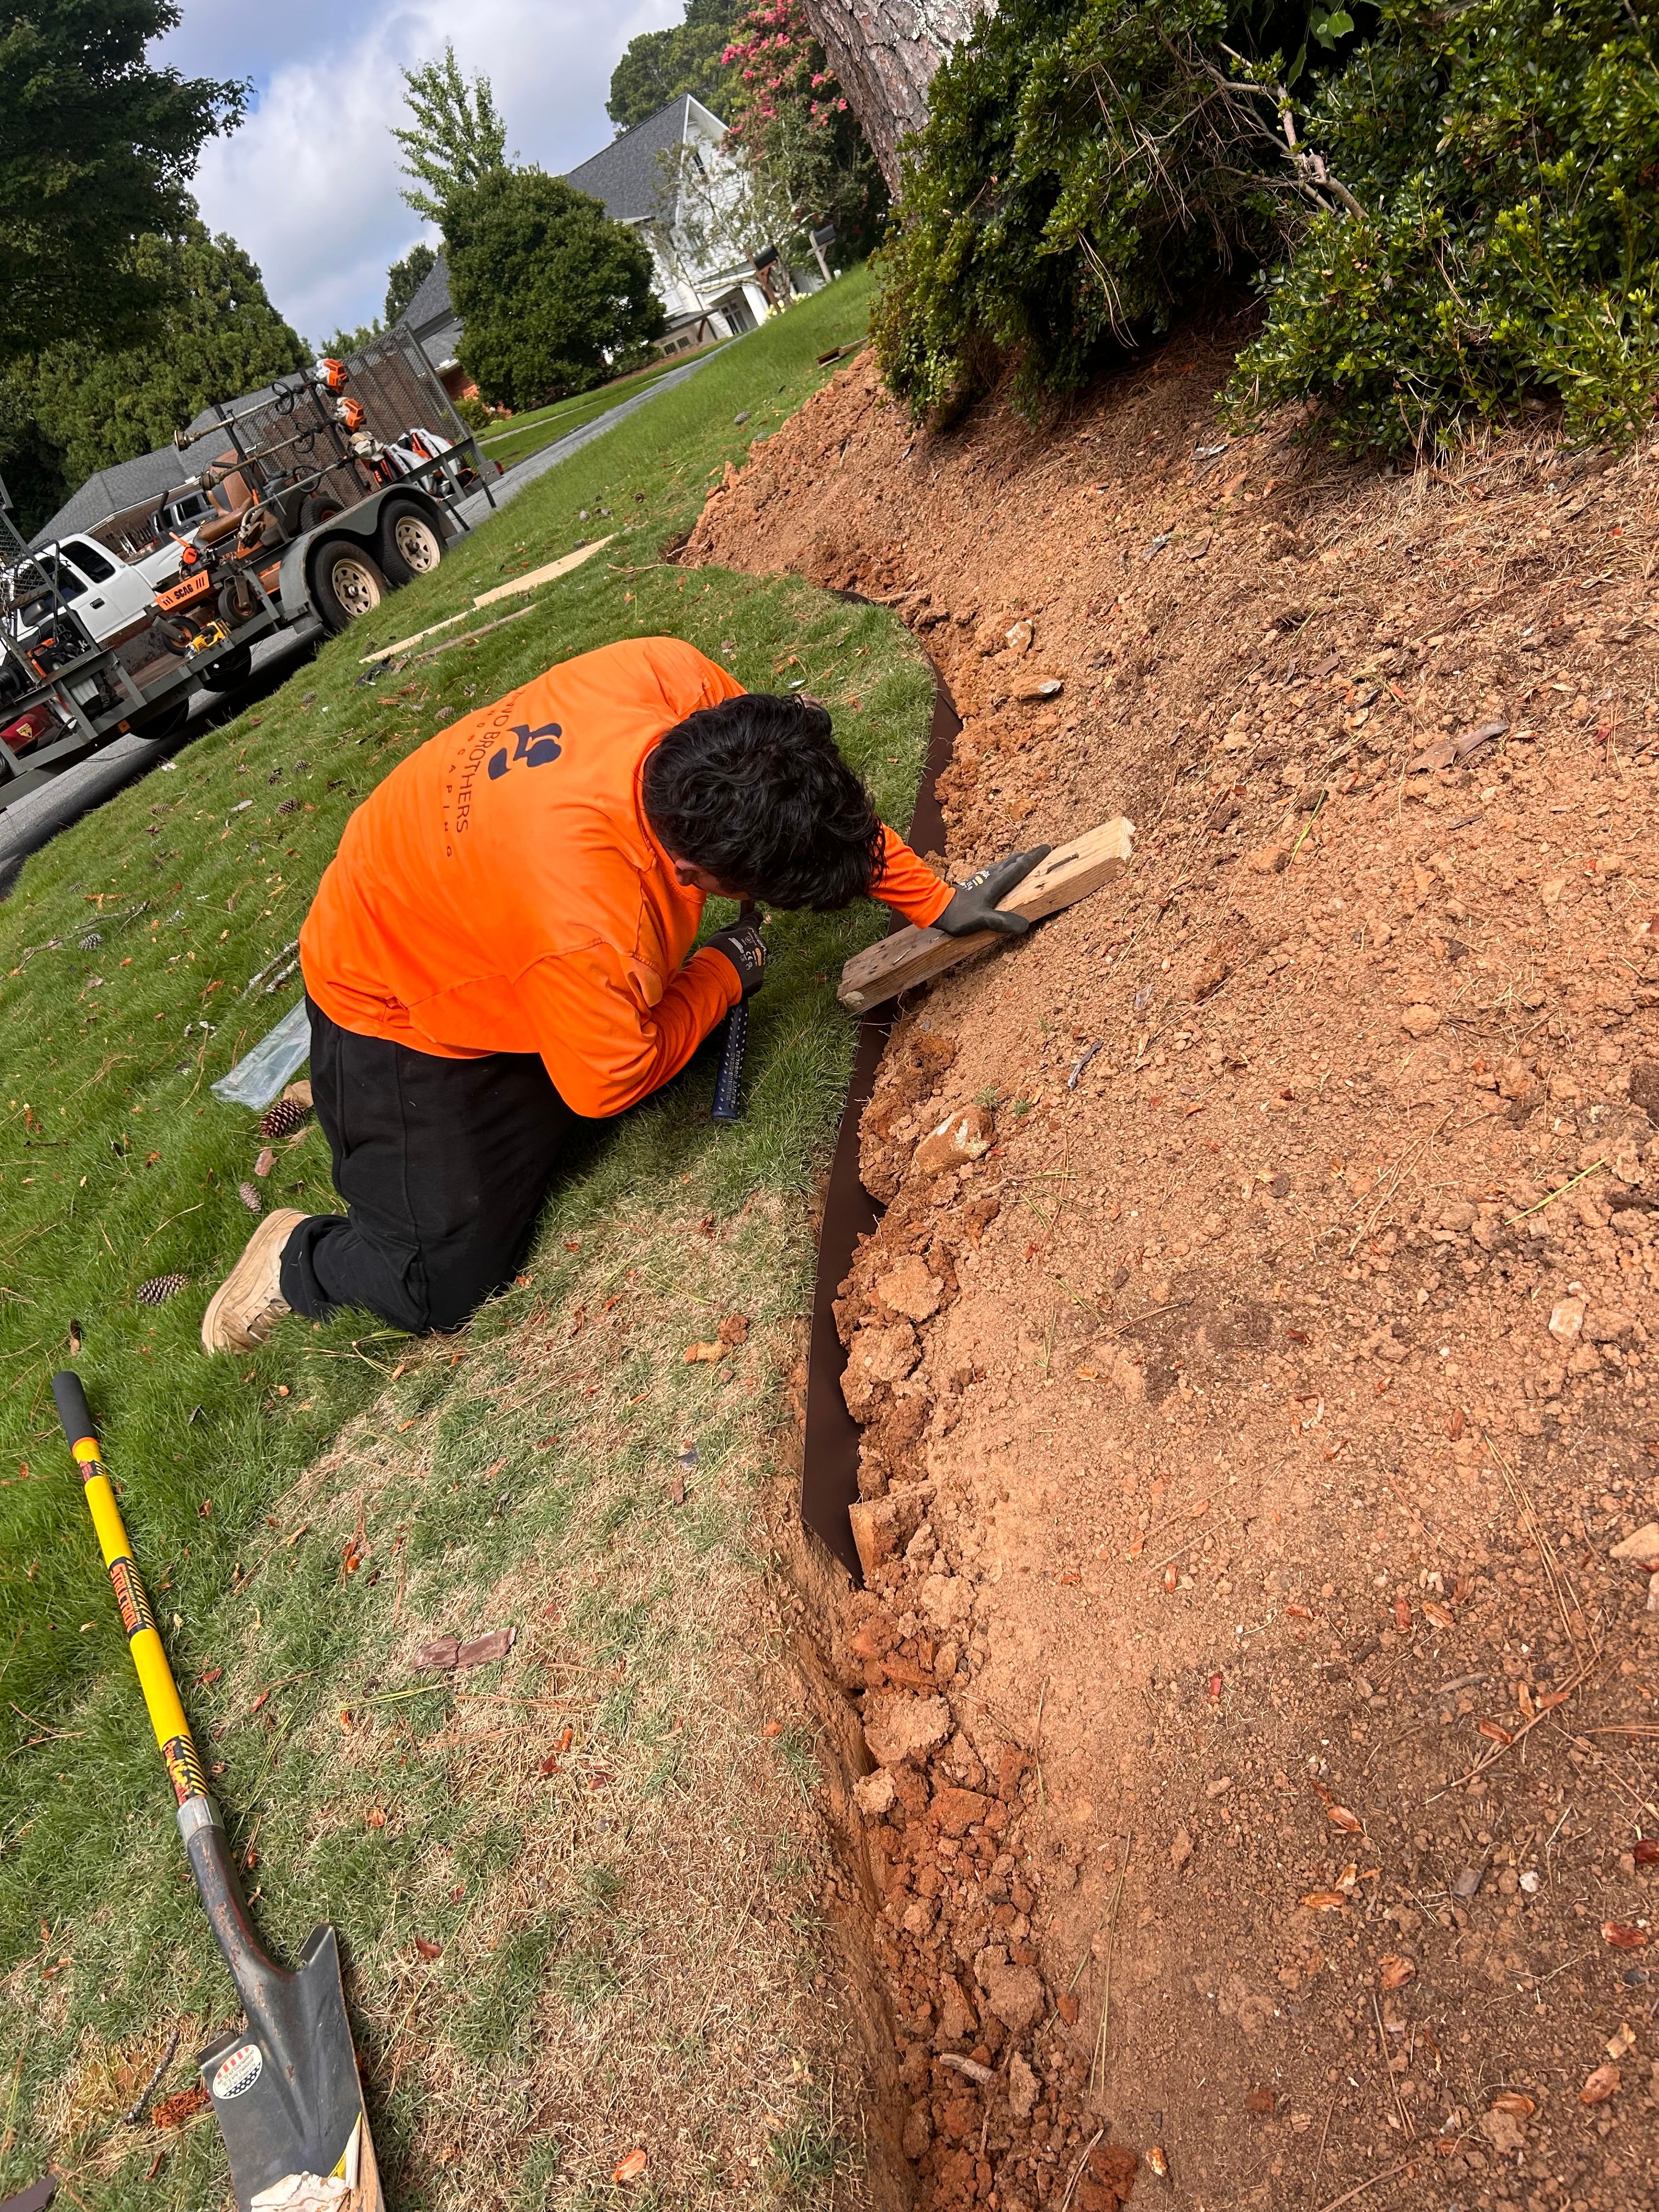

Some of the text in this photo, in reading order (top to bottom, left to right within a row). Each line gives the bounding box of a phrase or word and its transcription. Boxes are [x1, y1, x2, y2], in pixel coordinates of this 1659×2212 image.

[174, 584, 194, 600] SCAG
[456, 731, 501, 833] BROTHERS
[110, 1563, 138, 1633] STRUCTRON
